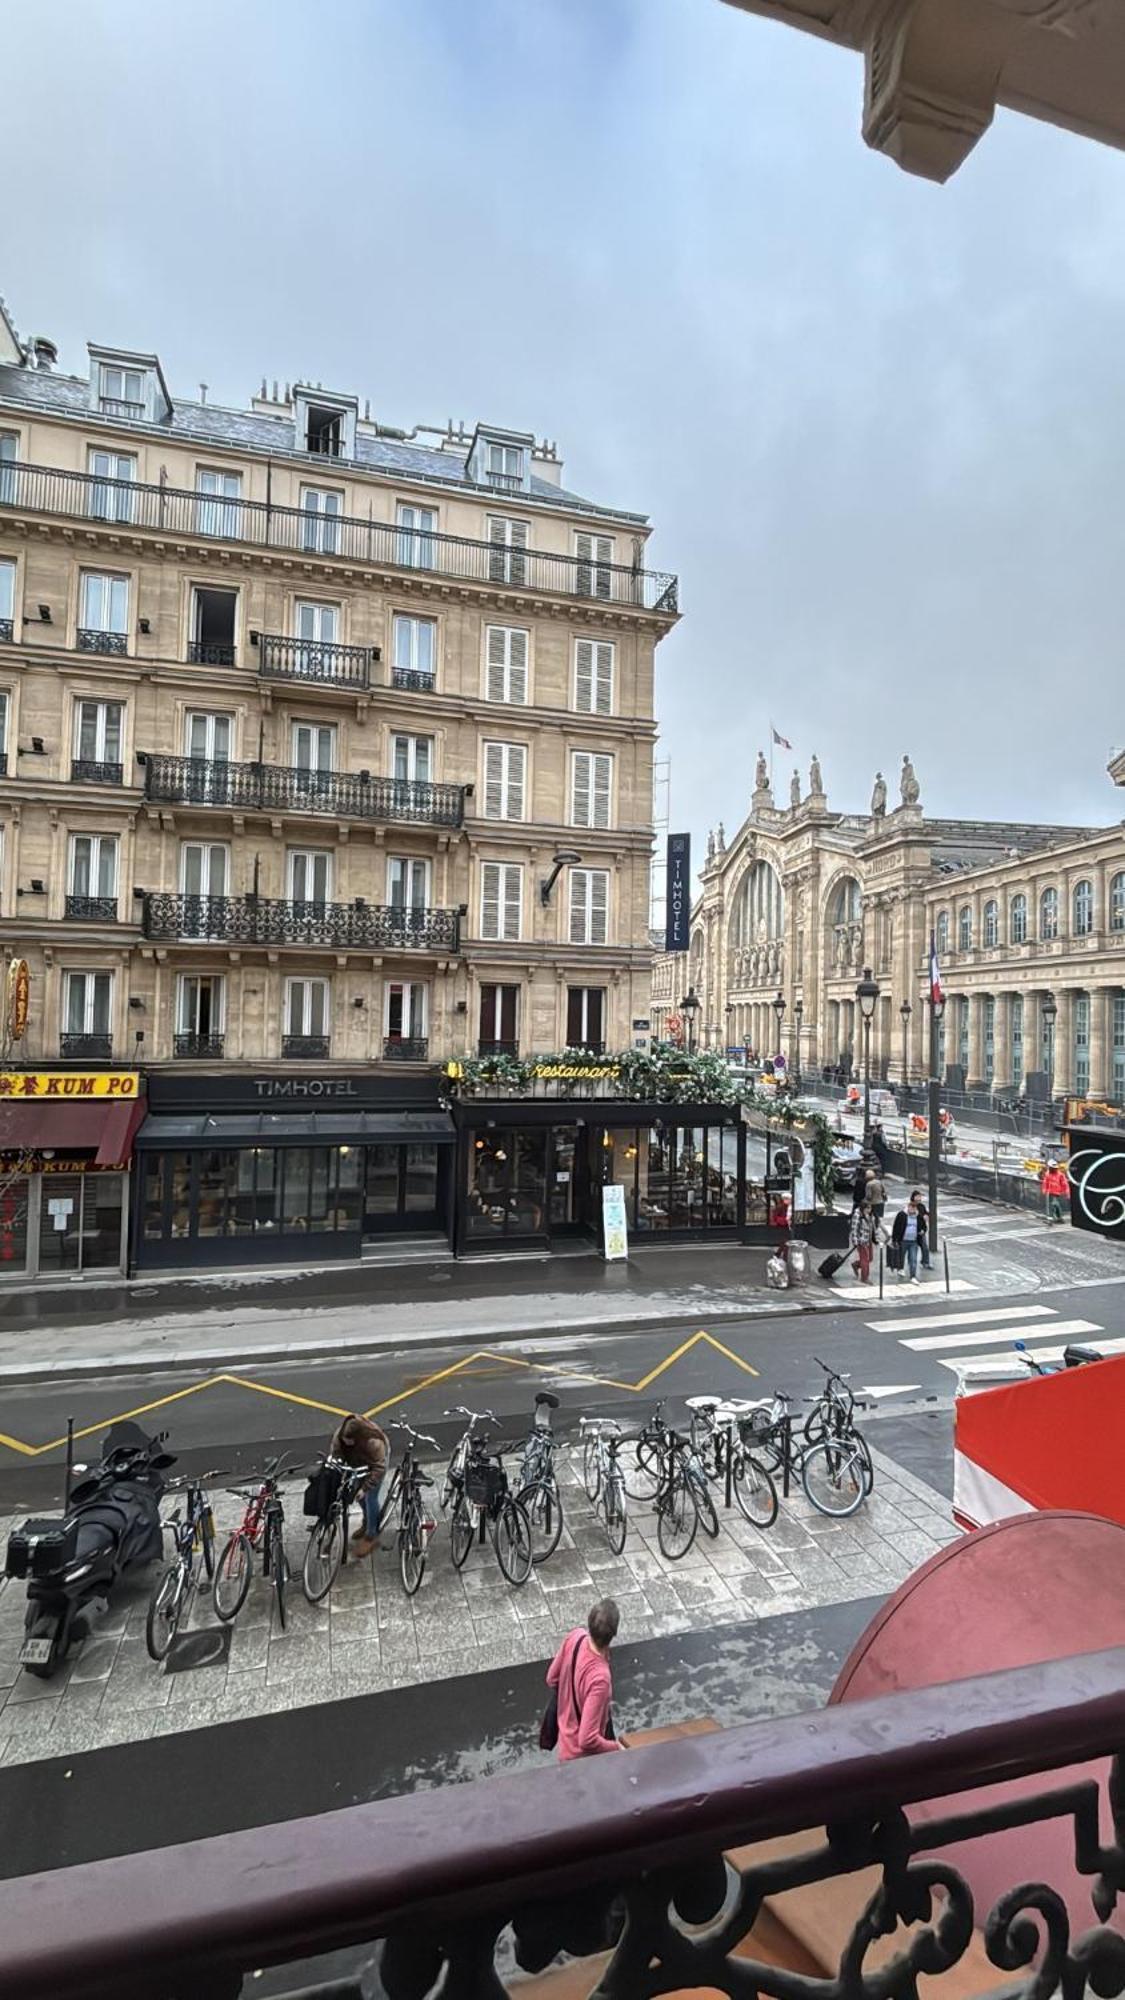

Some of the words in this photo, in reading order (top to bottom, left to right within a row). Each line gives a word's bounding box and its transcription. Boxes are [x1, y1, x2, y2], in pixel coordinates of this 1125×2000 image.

[672, 859, 682, 941] TIMHOTEL
[45, 1078, 97, 1094] KUM
[106, 1078, 134, 1094] PO
[254, 1080, 358, 1096] TIMHOTEL
[44, 1162, 86, 1171] KUM
